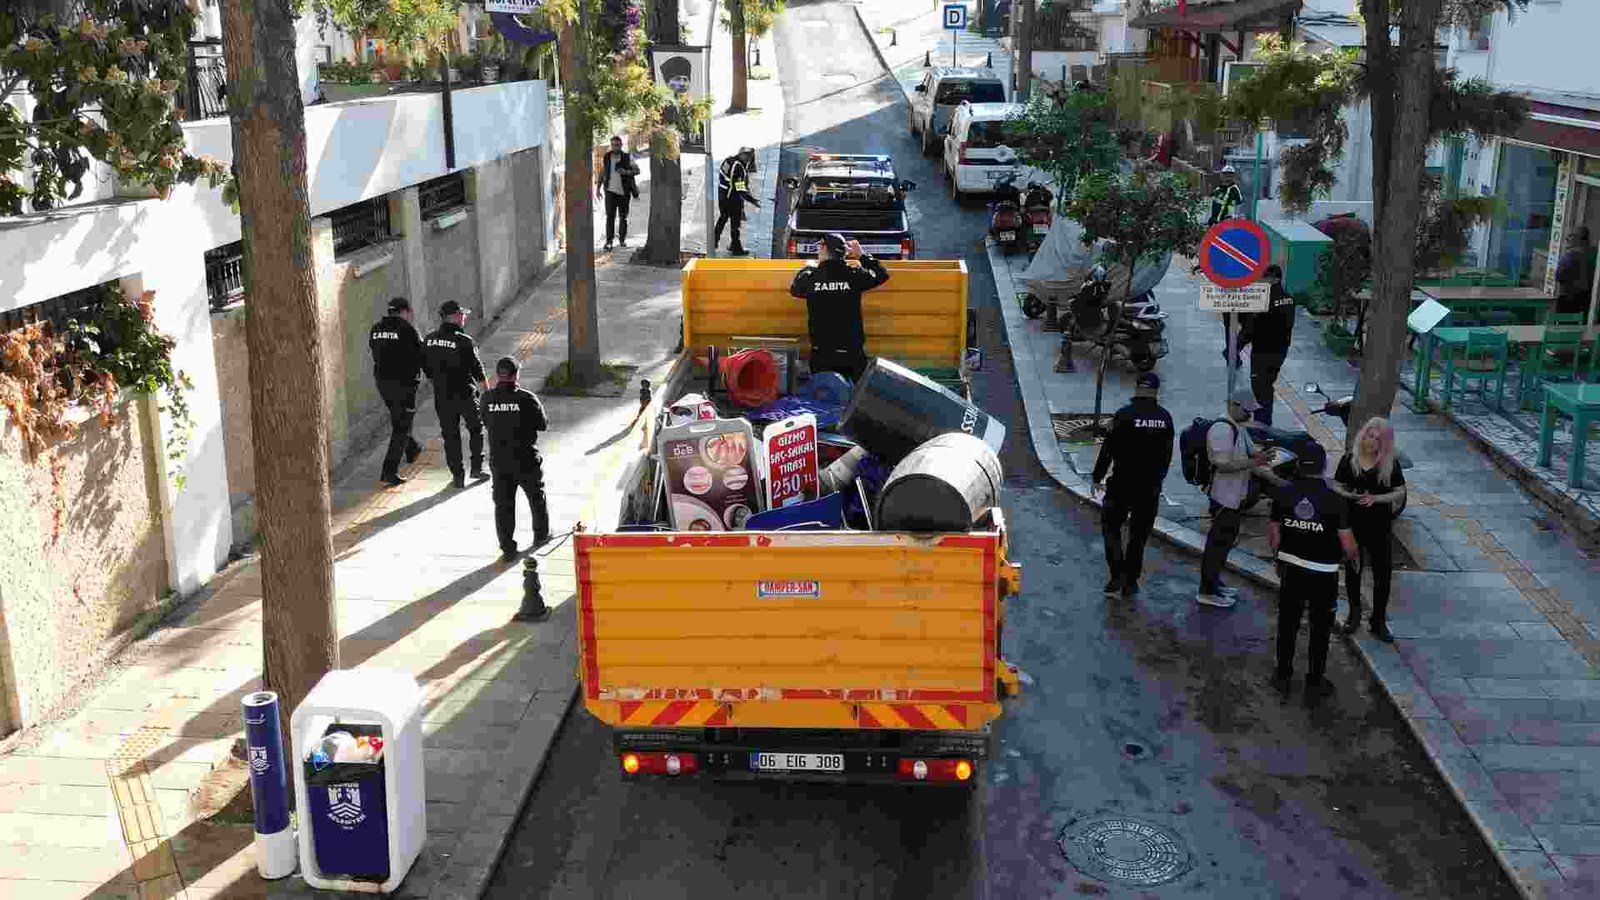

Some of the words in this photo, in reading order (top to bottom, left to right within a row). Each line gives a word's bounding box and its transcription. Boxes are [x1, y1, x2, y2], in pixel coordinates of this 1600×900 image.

[949, 10, 960, 24] D
[814, 281, 851, 291] ZABITA
[372, 332, 399, 340] ZABITA
[427, 339, 456, 349] ZABITA
[488, 403, 520, 412] ZABITA
[1134, 419, 1167, 428] ZABITA
[772, 473, 801, 500] 250
[1284, 518, 1324, 532] ZABITA
[760, 754, 776, 767] 06
[786, 755, 807, 768] EIG
[816, 755, 841, 769] 308
